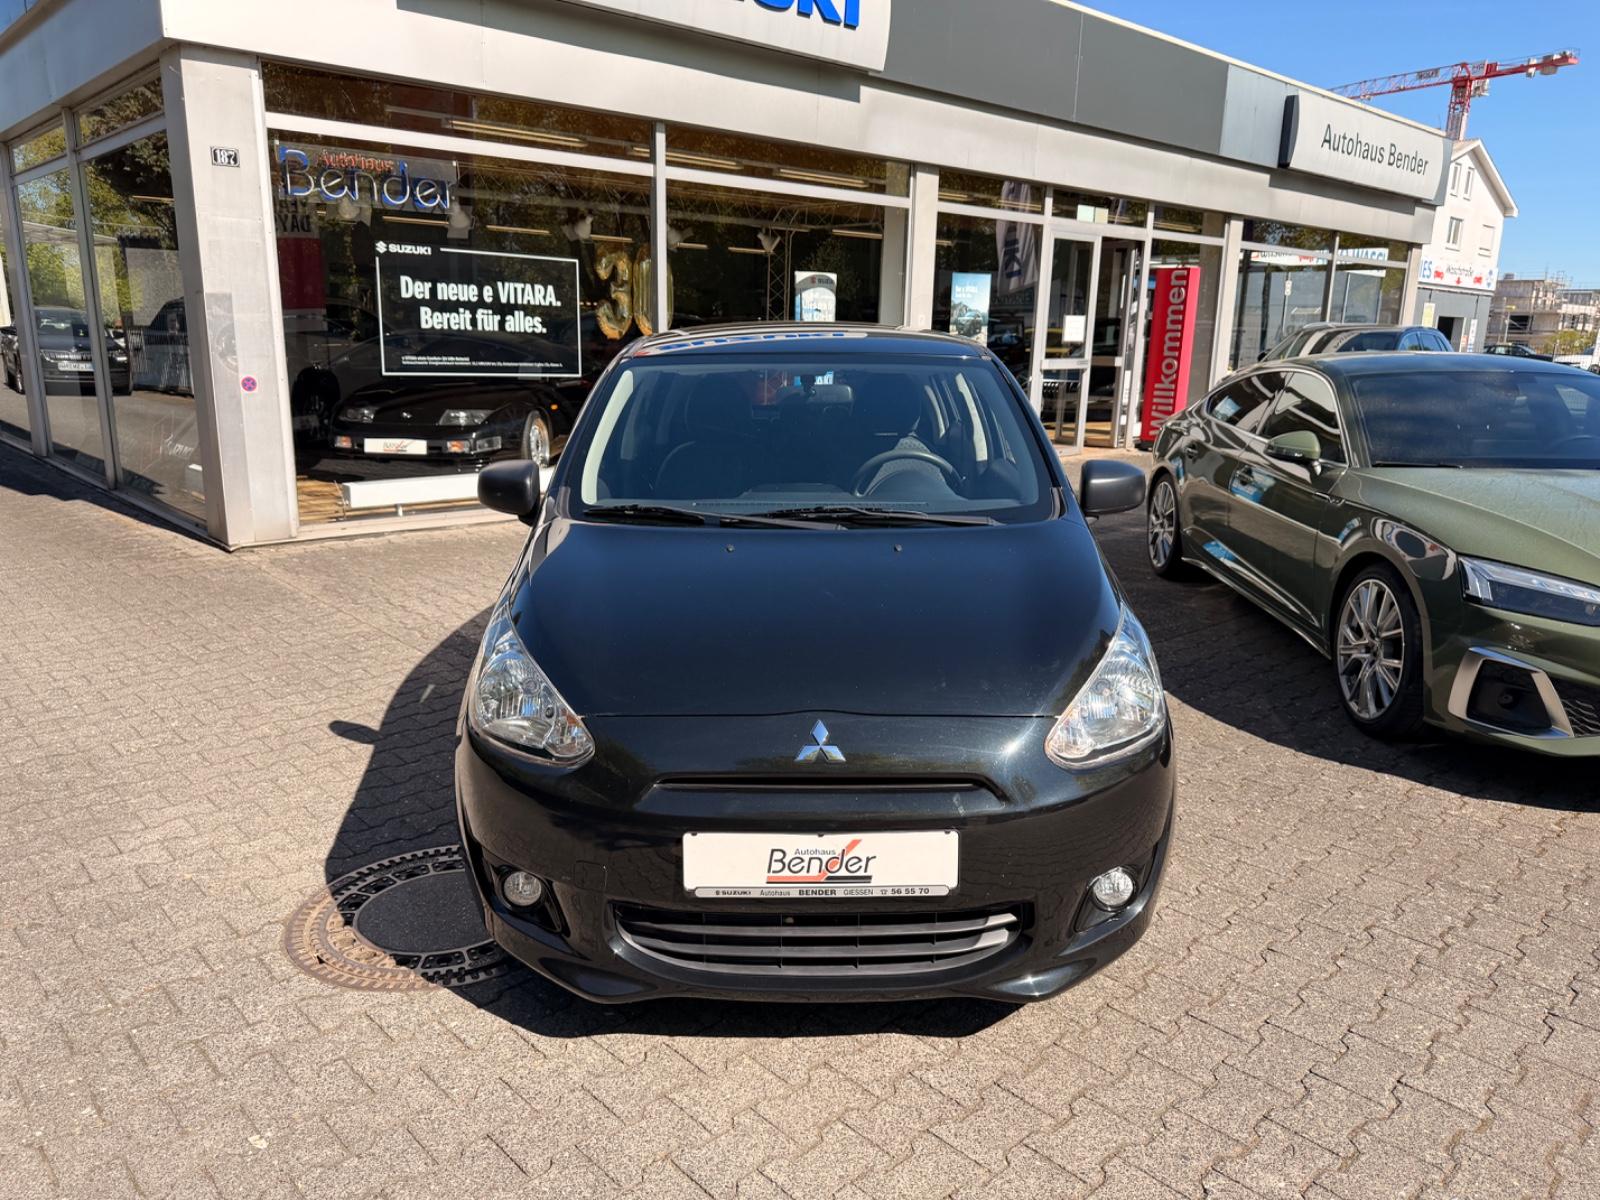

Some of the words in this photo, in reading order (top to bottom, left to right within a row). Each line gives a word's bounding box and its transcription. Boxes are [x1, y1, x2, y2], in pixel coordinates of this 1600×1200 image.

[215, 149, 235, 166] 187
[1321, 123, 1385, 164] Autohaus
[1387, 142, 1429, 175] Bender
[279, 148, 452, 208] Bender
[388, 243, 432, 255] SUZUKI
[400, 275, 432, 299] Der
[436, 282, 479, 303] neue
[483, 285, 494, 303] e
[497, 281, 562, 307] VITARA.
[420, 306, 473, 331] Bereit
[476, 308, 501, 332] für
[505, 311, 547, 334] alles.
[1149, 268, 1188, 438] Willkommen
[767, 848, 876, 875] Bender
[794, 848, 836, 856] Autohaus
[760, 889, 791, 897] Autohaus
[843, 888, 874, 896] GIESSEN
[918, 887, 930, 895] 70
